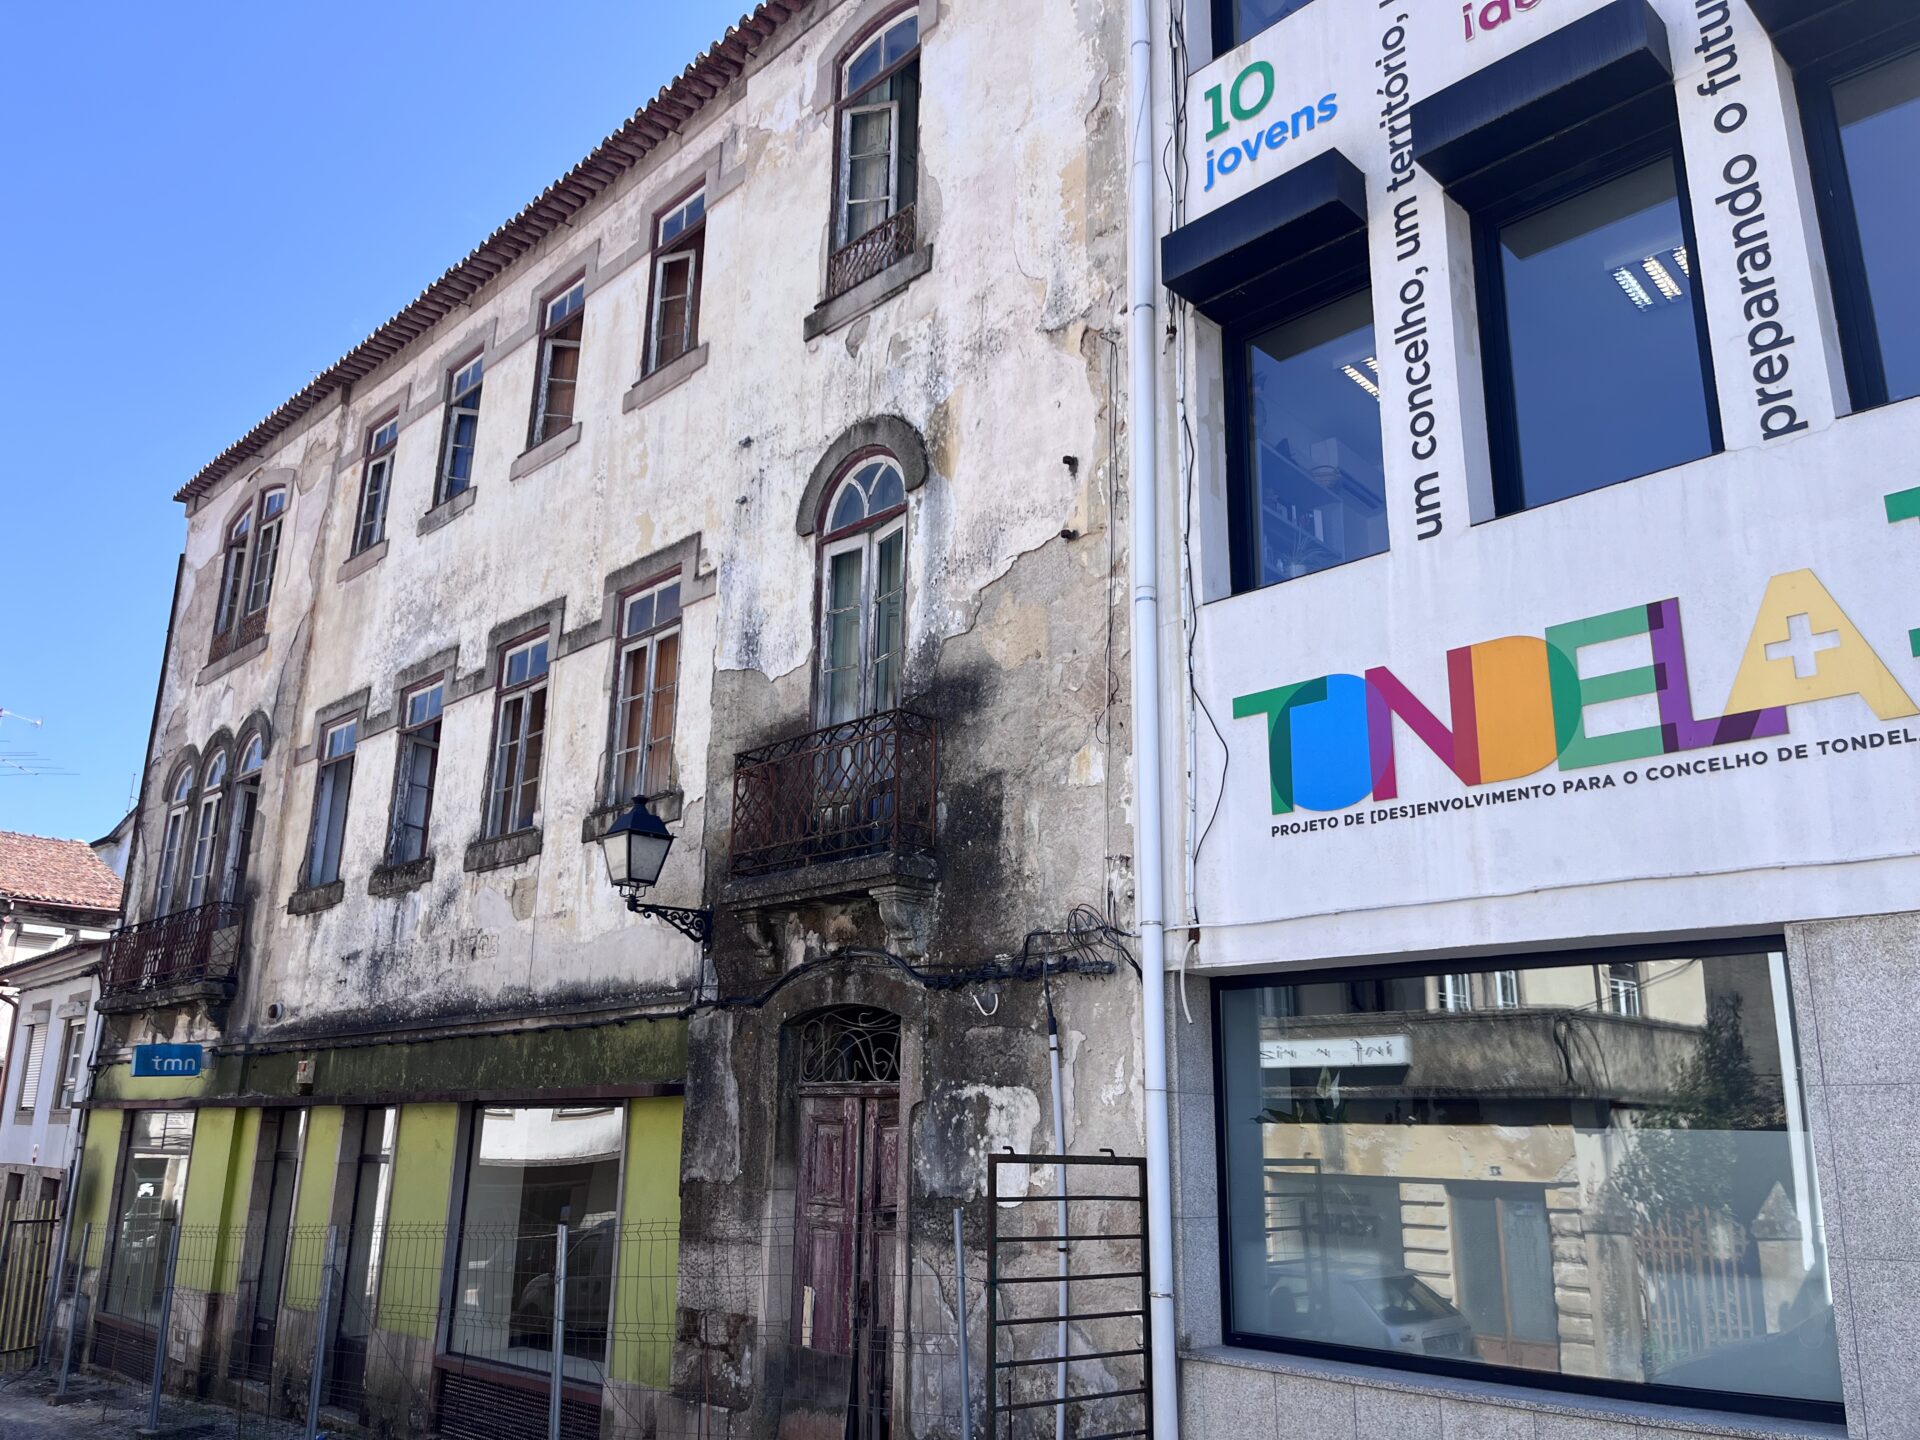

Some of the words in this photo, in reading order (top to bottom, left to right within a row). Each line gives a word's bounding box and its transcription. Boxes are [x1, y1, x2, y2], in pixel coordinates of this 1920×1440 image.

[1694, 0, 1742, 97] futu
[1204, 60, 1275, 142] 10
[1204, 93, 1338, 192] jovens
[1375, 12, 1416, 193] território,
[1713, 102, 1748, 134] o
[1394, 195, 1421, 262] um
[1714, 153, 1808, 441] preparando
[1394, 265, 1437, 460] concelho,
[1416, 470, 1443, 542] um
[1233, 567, 1920, 816] TONDELA
[1271, 816, 1339, 838] PROJETO
[1344, 812, 1366, 827] DE
[1370, 782, 1557, 825] [DES]ENVOLVIMENTO
[1563, 774, 1616, 794] PARA
[1623, 771, 1638, 785] O
[1645, 750, 1769, 782] CONCELHO
[1777, 744, 1809, 763] DE
[1816, 727, 1920, 756] TONDEL
[152, 1055, 196, 1071] tmn
